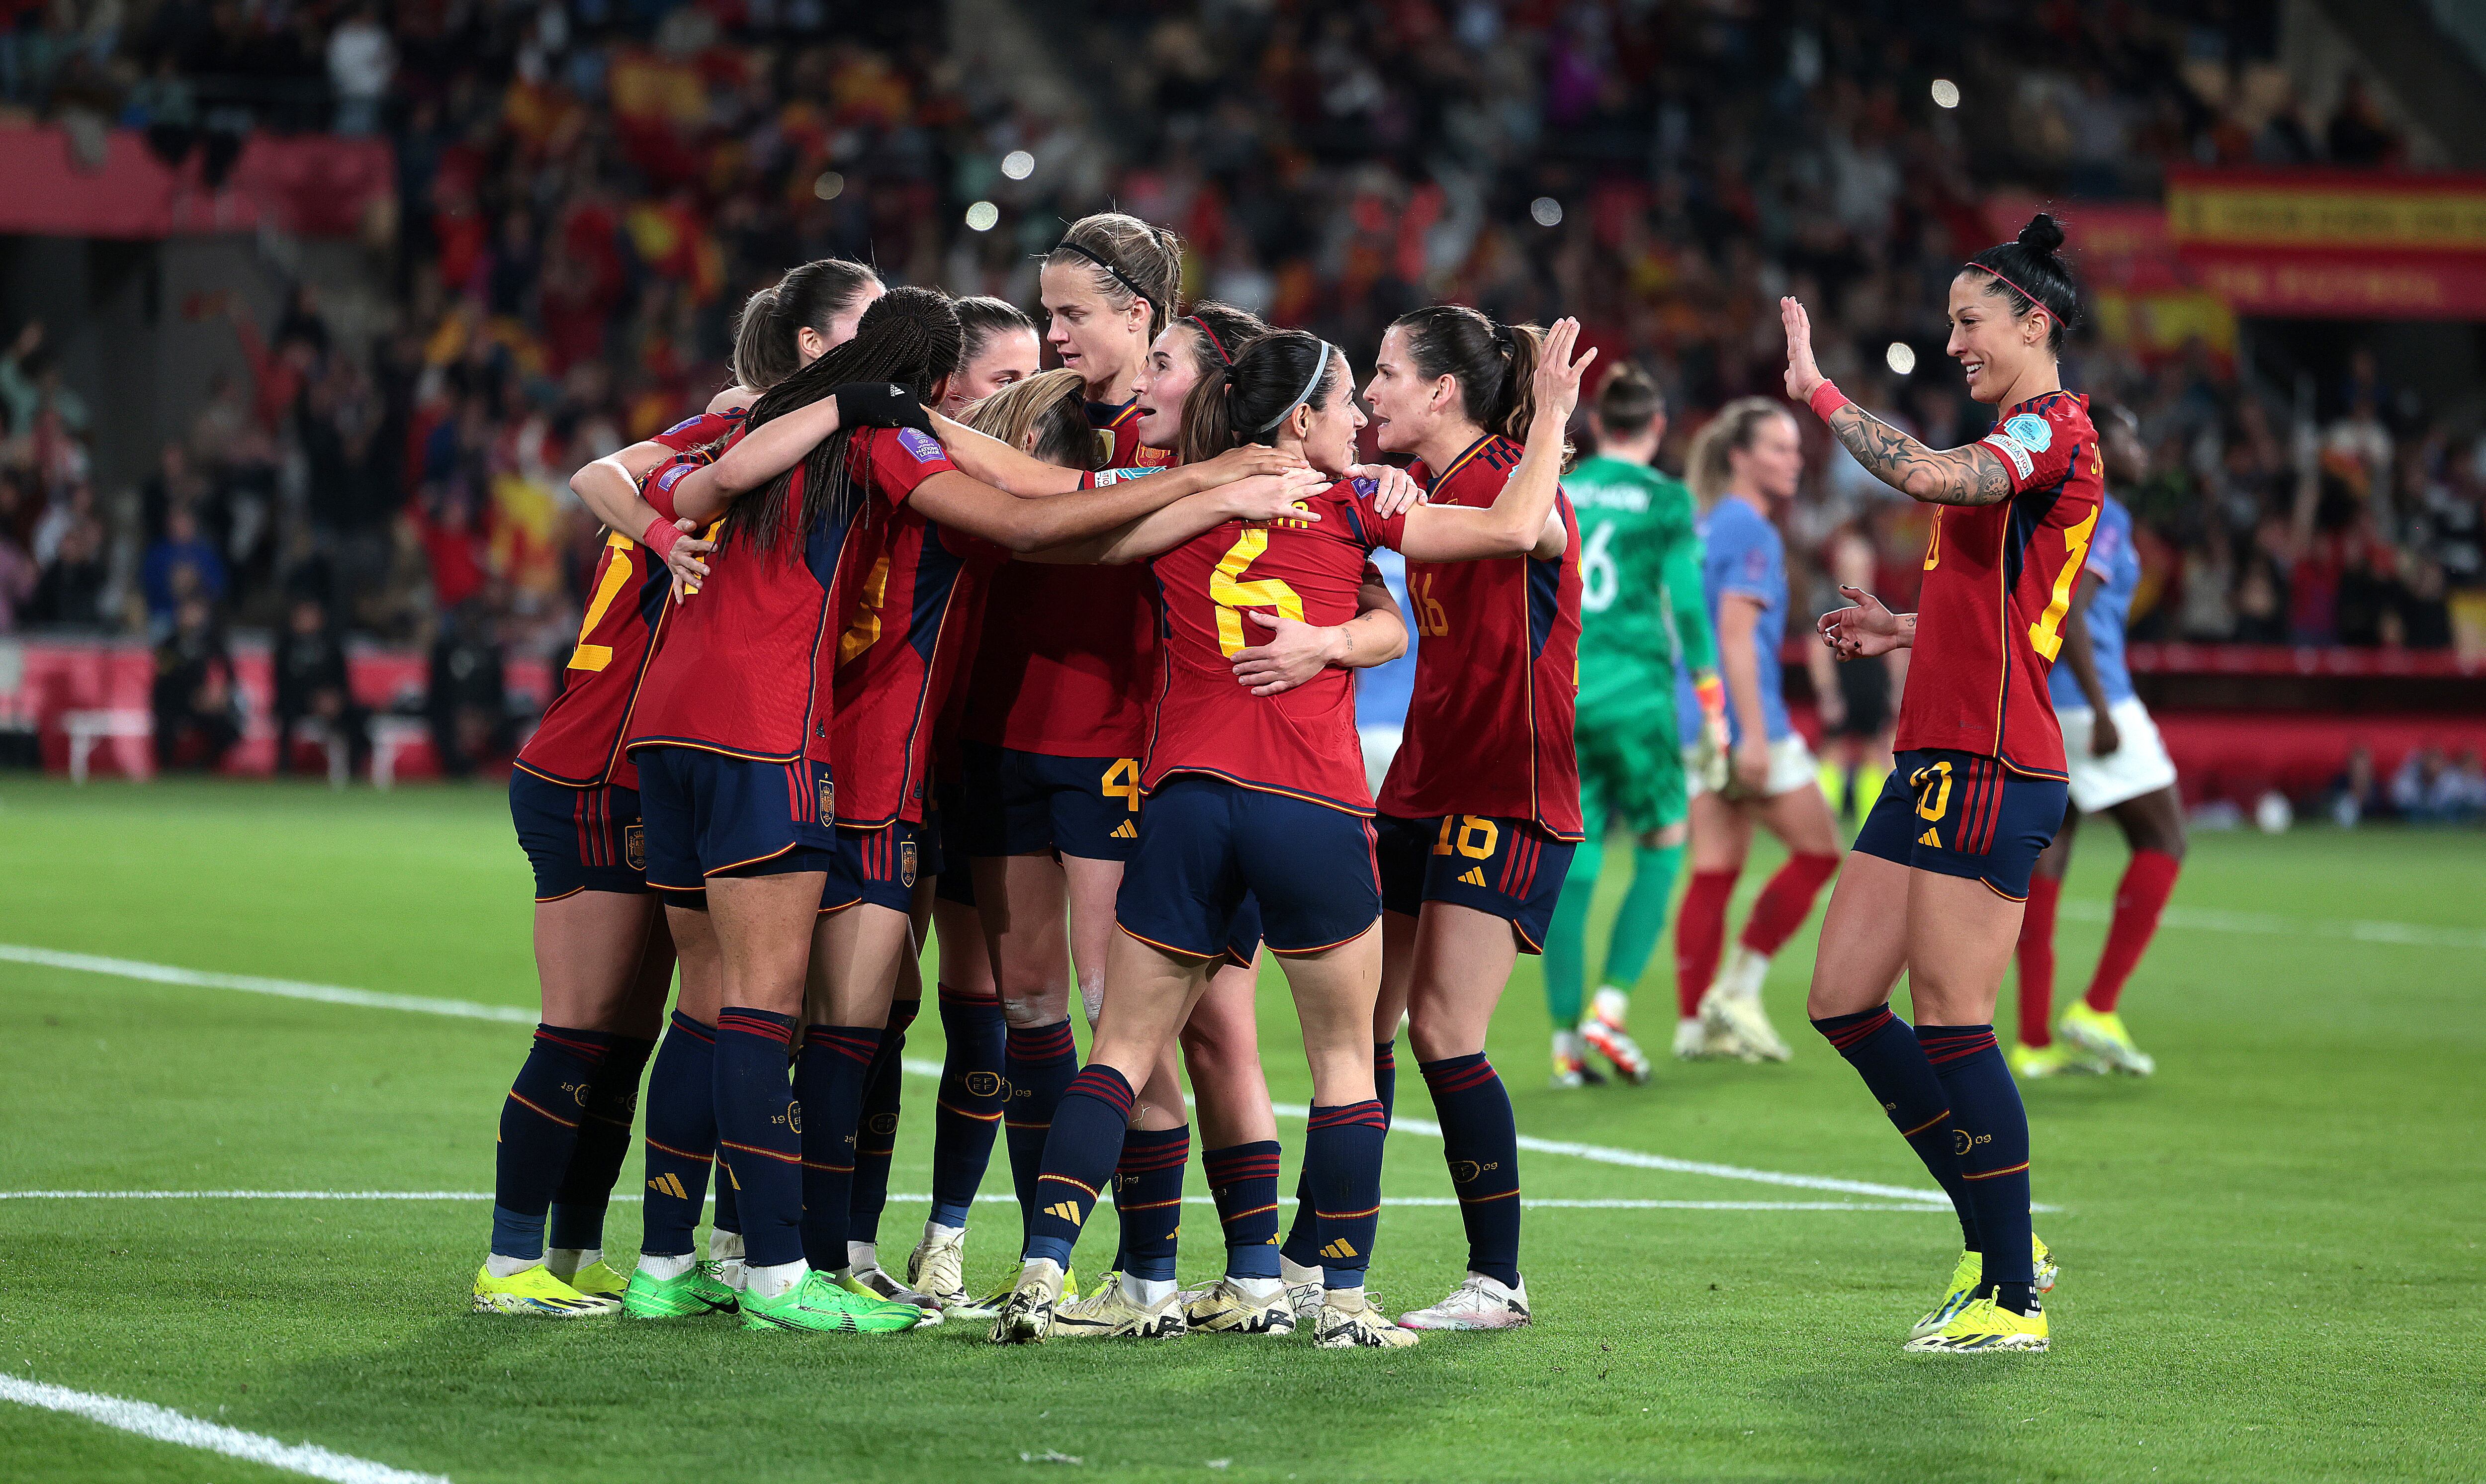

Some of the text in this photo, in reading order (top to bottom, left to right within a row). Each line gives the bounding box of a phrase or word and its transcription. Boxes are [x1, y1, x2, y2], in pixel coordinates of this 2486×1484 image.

[2019, 426, 2036, 440] strong
[915, 446, 939, 454] NATIONS
[1988, 436, 2030, 475] FOUNDATION
[1580, 520, 1620, 613] 6
[567, 529, 634, 672] 2
[1209, 529, 1306, 659] 6
[1409, 573, 1449, 637] 16
[1101, 758, 1139, 811] 4
[561, 1082, 574, 1092] 19
[771, 1115, 786, 1124] 19
[1975, 1134, 1992, 1144] 09
[1483, 1161, 1498, 1171] 09
[1119, 1318, 1134, 1328] OLIVER
